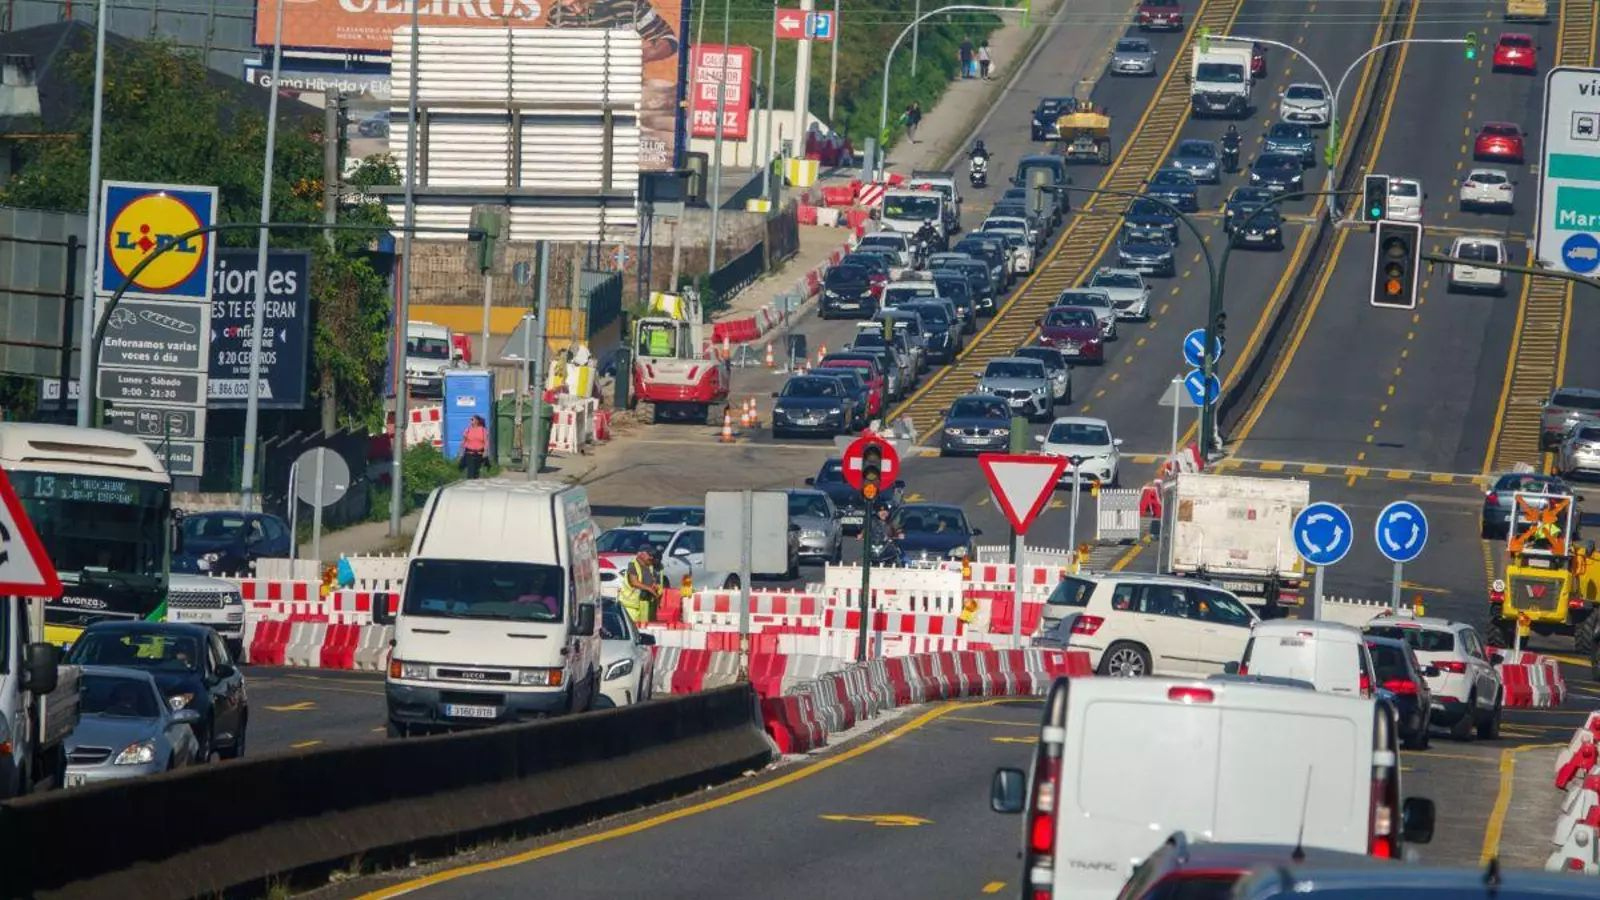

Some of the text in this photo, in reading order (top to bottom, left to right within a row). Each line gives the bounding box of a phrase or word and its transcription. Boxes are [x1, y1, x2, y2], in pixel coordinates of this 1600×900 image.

[359, 82, 368, 95] y
[1559, 209, 1600, 226] Mar
[228, 301, 242, 318] TE
[245, 301, 296, 318] ESERAN
[105, 337, 198, 351] Enfornamos varias
[118, 375, 142, 384] Lunes
[122, 388, 142, 396] 9:00
[34, 476, 55, 497] 13
[62, 596, 98, 606] avanza
[1069, 860, 1117, 872] TRAFIC
